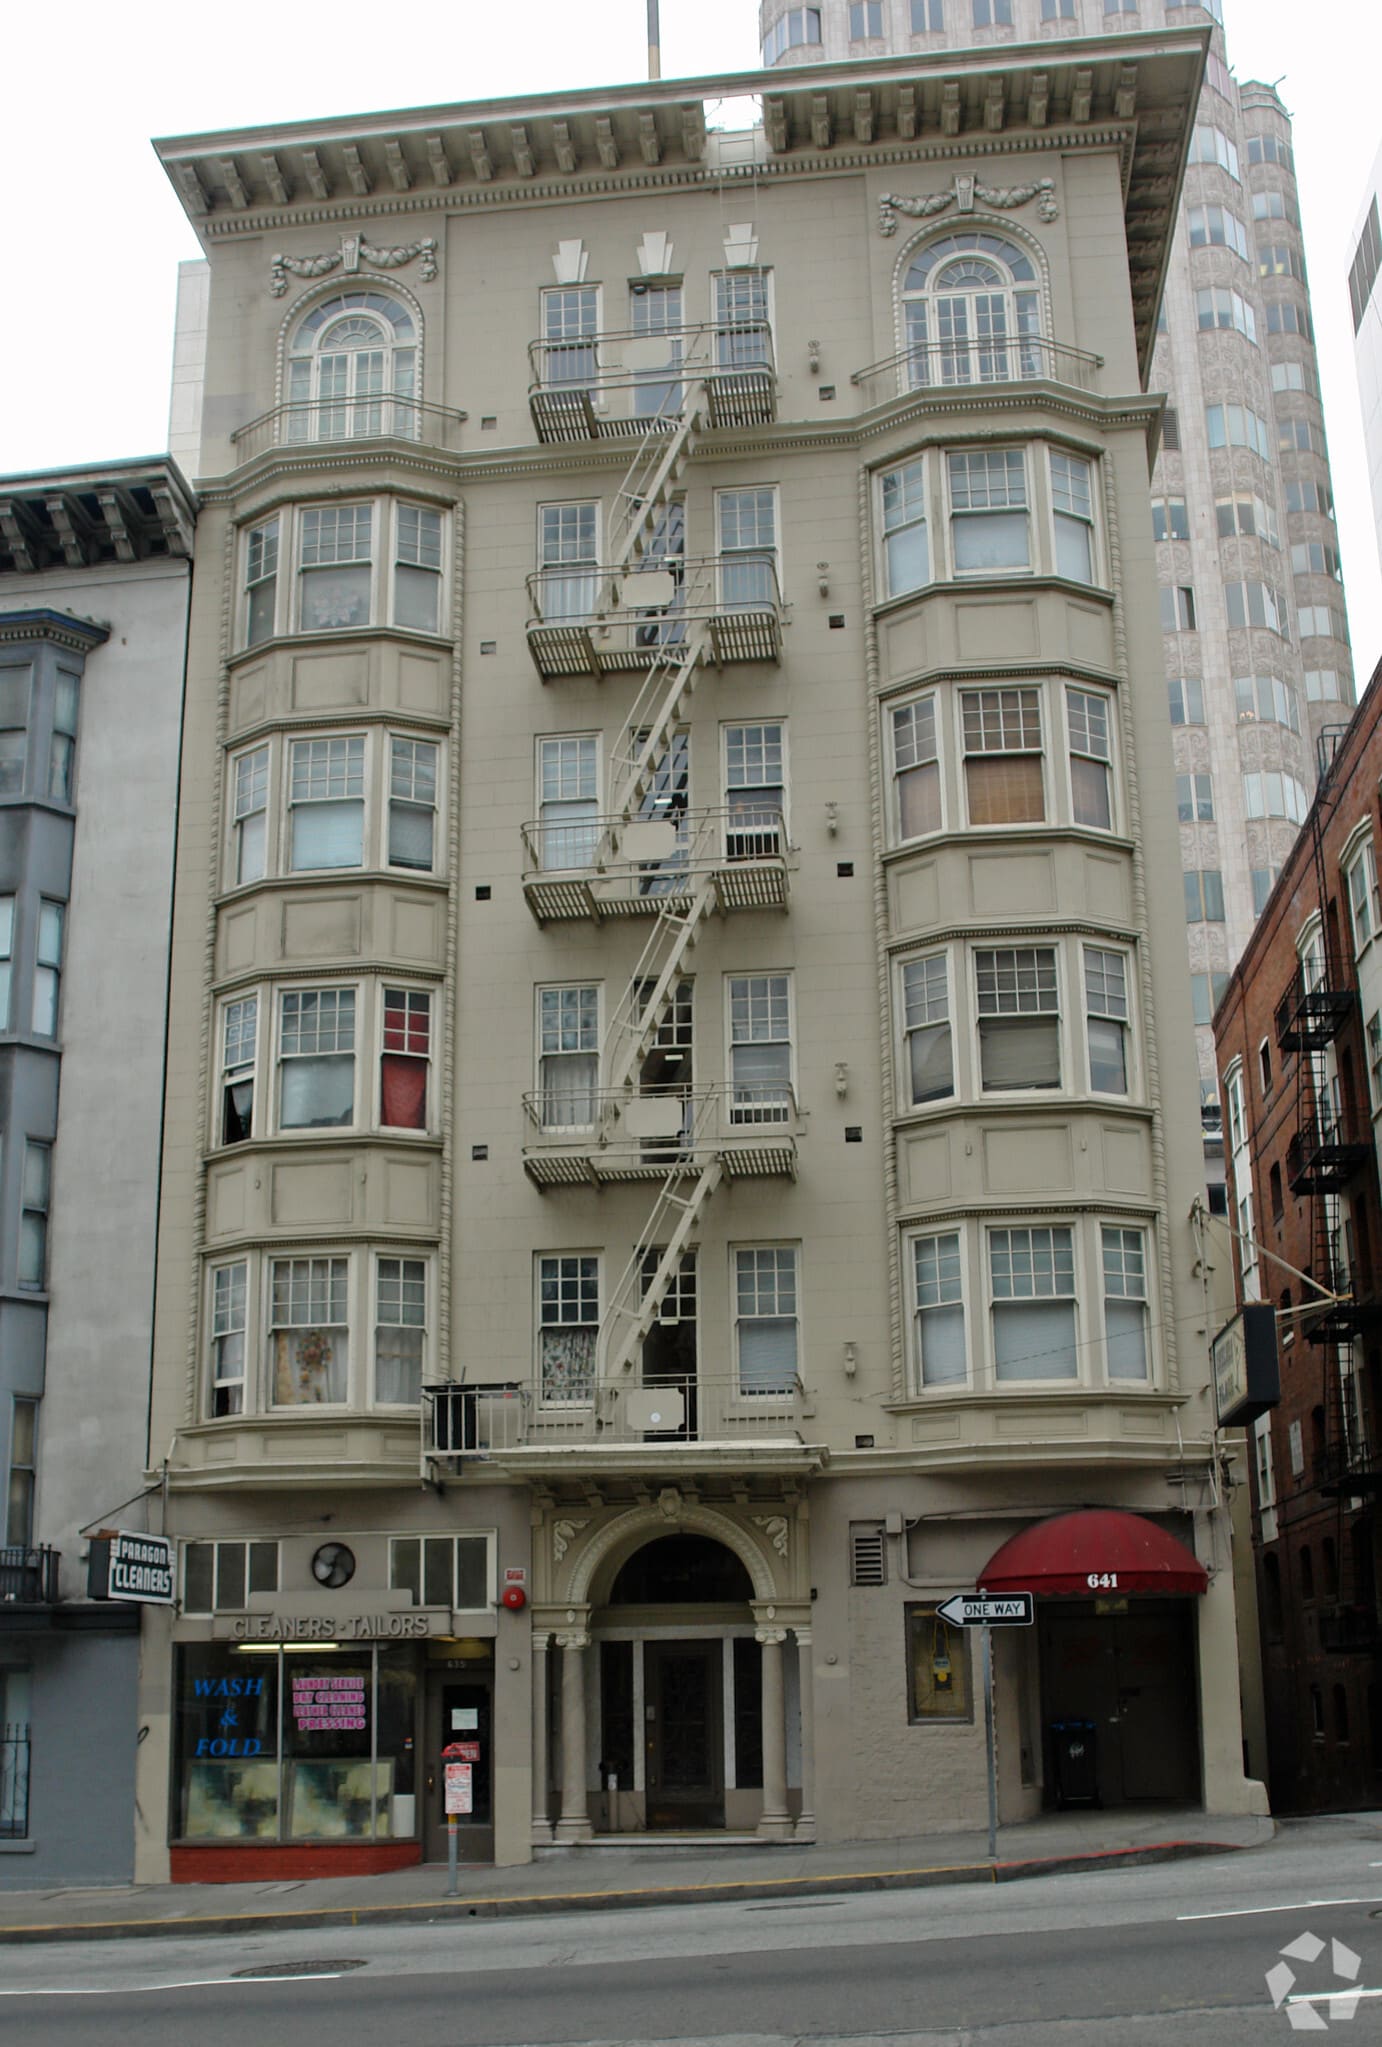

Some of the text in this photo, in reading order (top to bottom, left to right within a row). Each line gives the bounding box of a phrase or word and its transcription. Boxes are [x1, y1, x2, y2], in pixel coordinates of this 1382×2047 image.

[121, 1541, 166, 1564] PARAGON
[115, 1563, 170, 1592] CLEANERS
[1087, 1573, 1118, 1588] 641
[964, 1603, 1021, 1616] ONE WAY
[233, 1615, 429, 1638] CLEANERS TAILORS
[194, 1678, 264, 1696] WASH
[293, 1691, 314, 1704] DRY
[220, 1708, 239, 1726] &
[298, 1717, 366, 1730] PRESSING
[195, 1738, 260, 1757] FOLD
